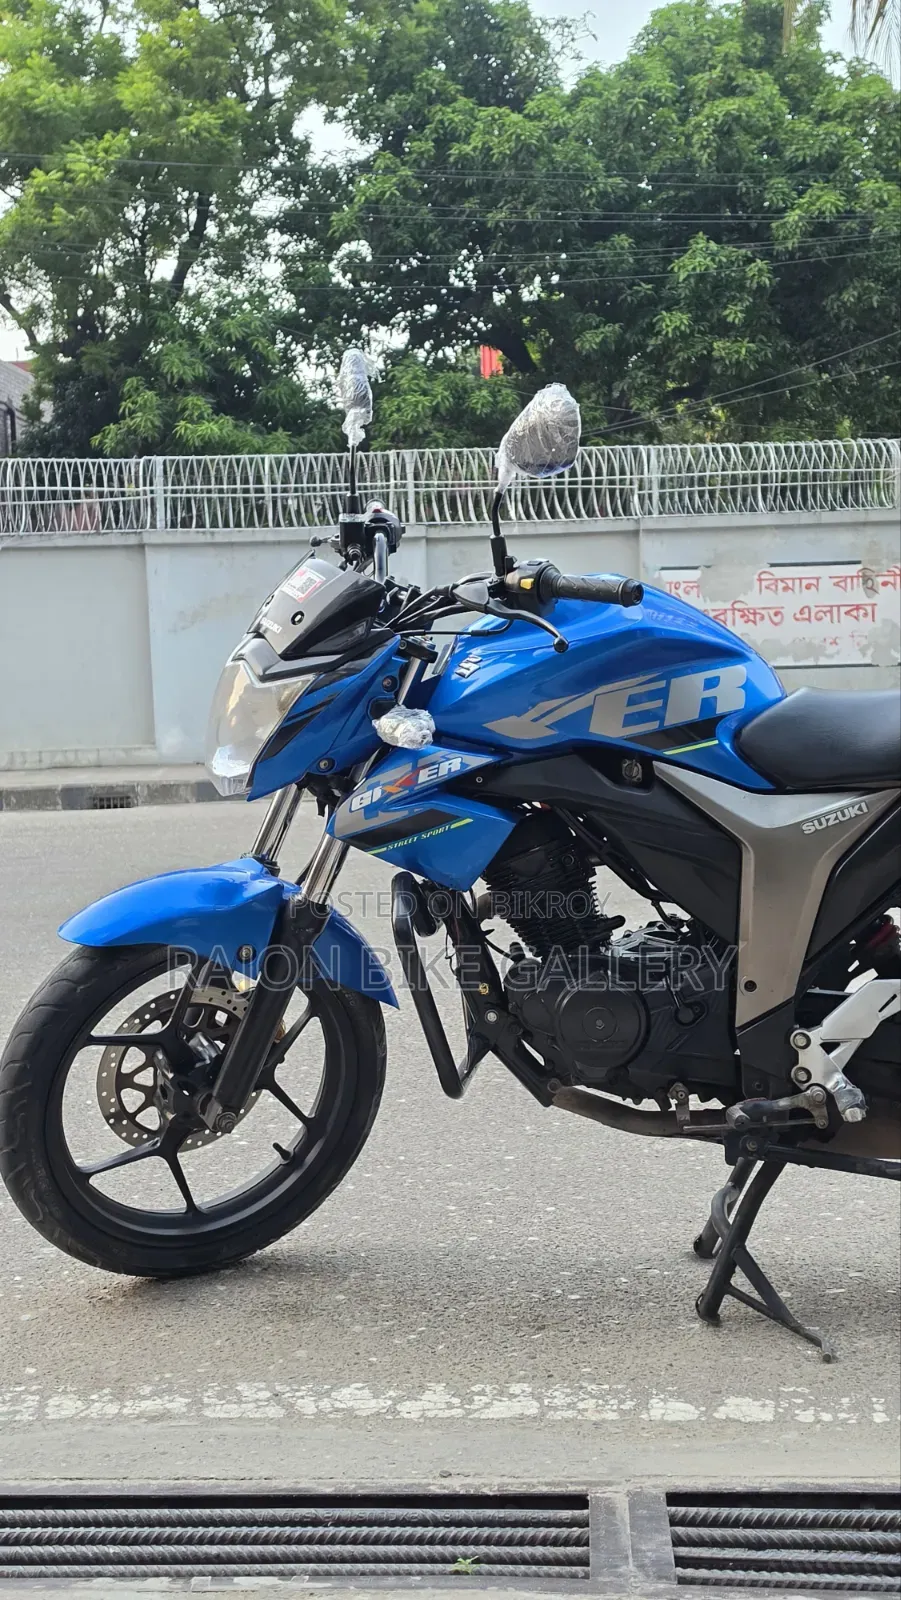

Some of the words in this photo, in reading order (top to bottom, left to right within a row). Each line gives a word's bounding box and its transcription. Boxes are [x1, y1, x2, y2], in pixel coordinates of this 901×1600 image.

[757, 571, 821, 595] বিমান
[793, 603, 877, 624] এলাকা
[801, 802, 869, 835] SUZUKI
[387, 836, 419, 851] STREET
[421, 825, 450, 840] SPORT
